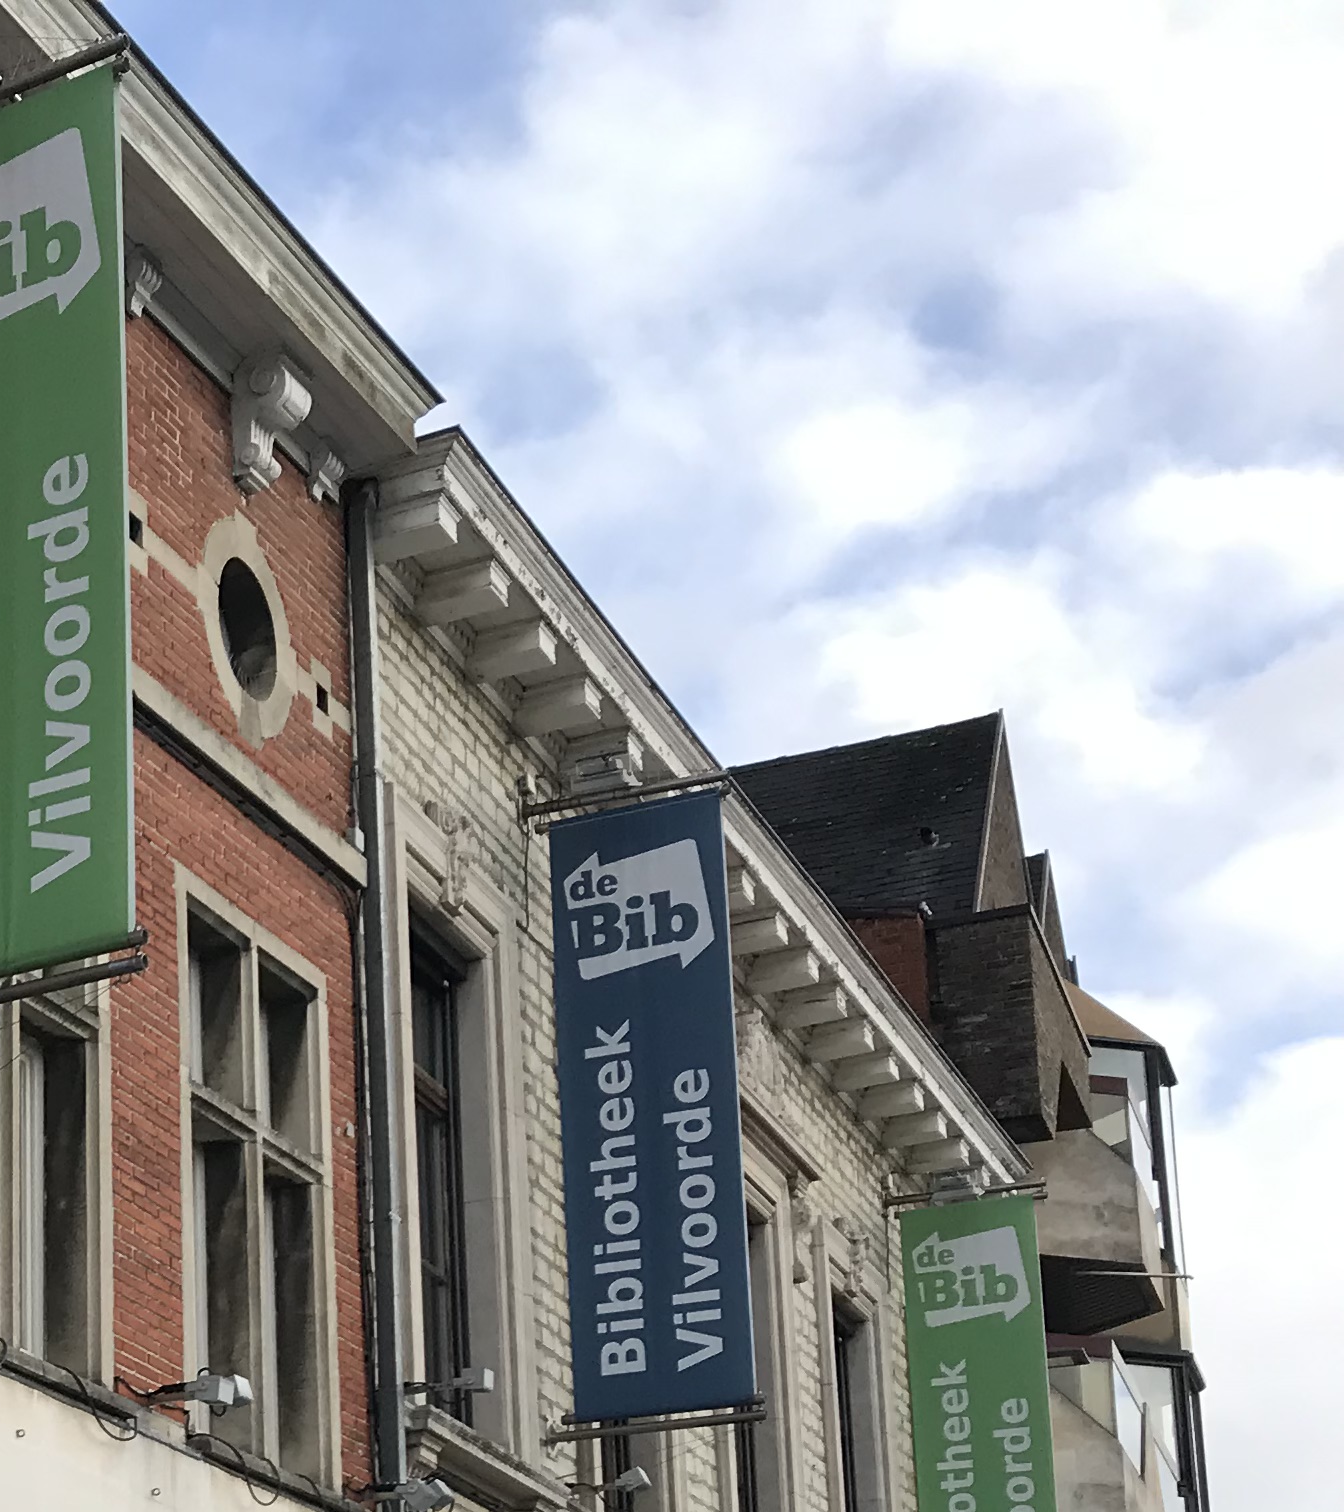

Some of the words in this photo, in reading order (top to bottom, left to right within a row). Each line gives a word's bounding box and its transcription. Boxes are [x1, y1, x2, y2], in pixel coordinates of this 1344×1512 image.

[28, 453, 91, 893] Vilvoorde
[568, 870, 618, 903] de
[570, 890, 700, 958] Bib
[584, 1018, 646, 1377] Bibliotheek
[663, 1066, 724, 1372] Vilvoorde
[917, 1244, 955, 1268] de
[918, 1264, 1019, 1311] Bib
